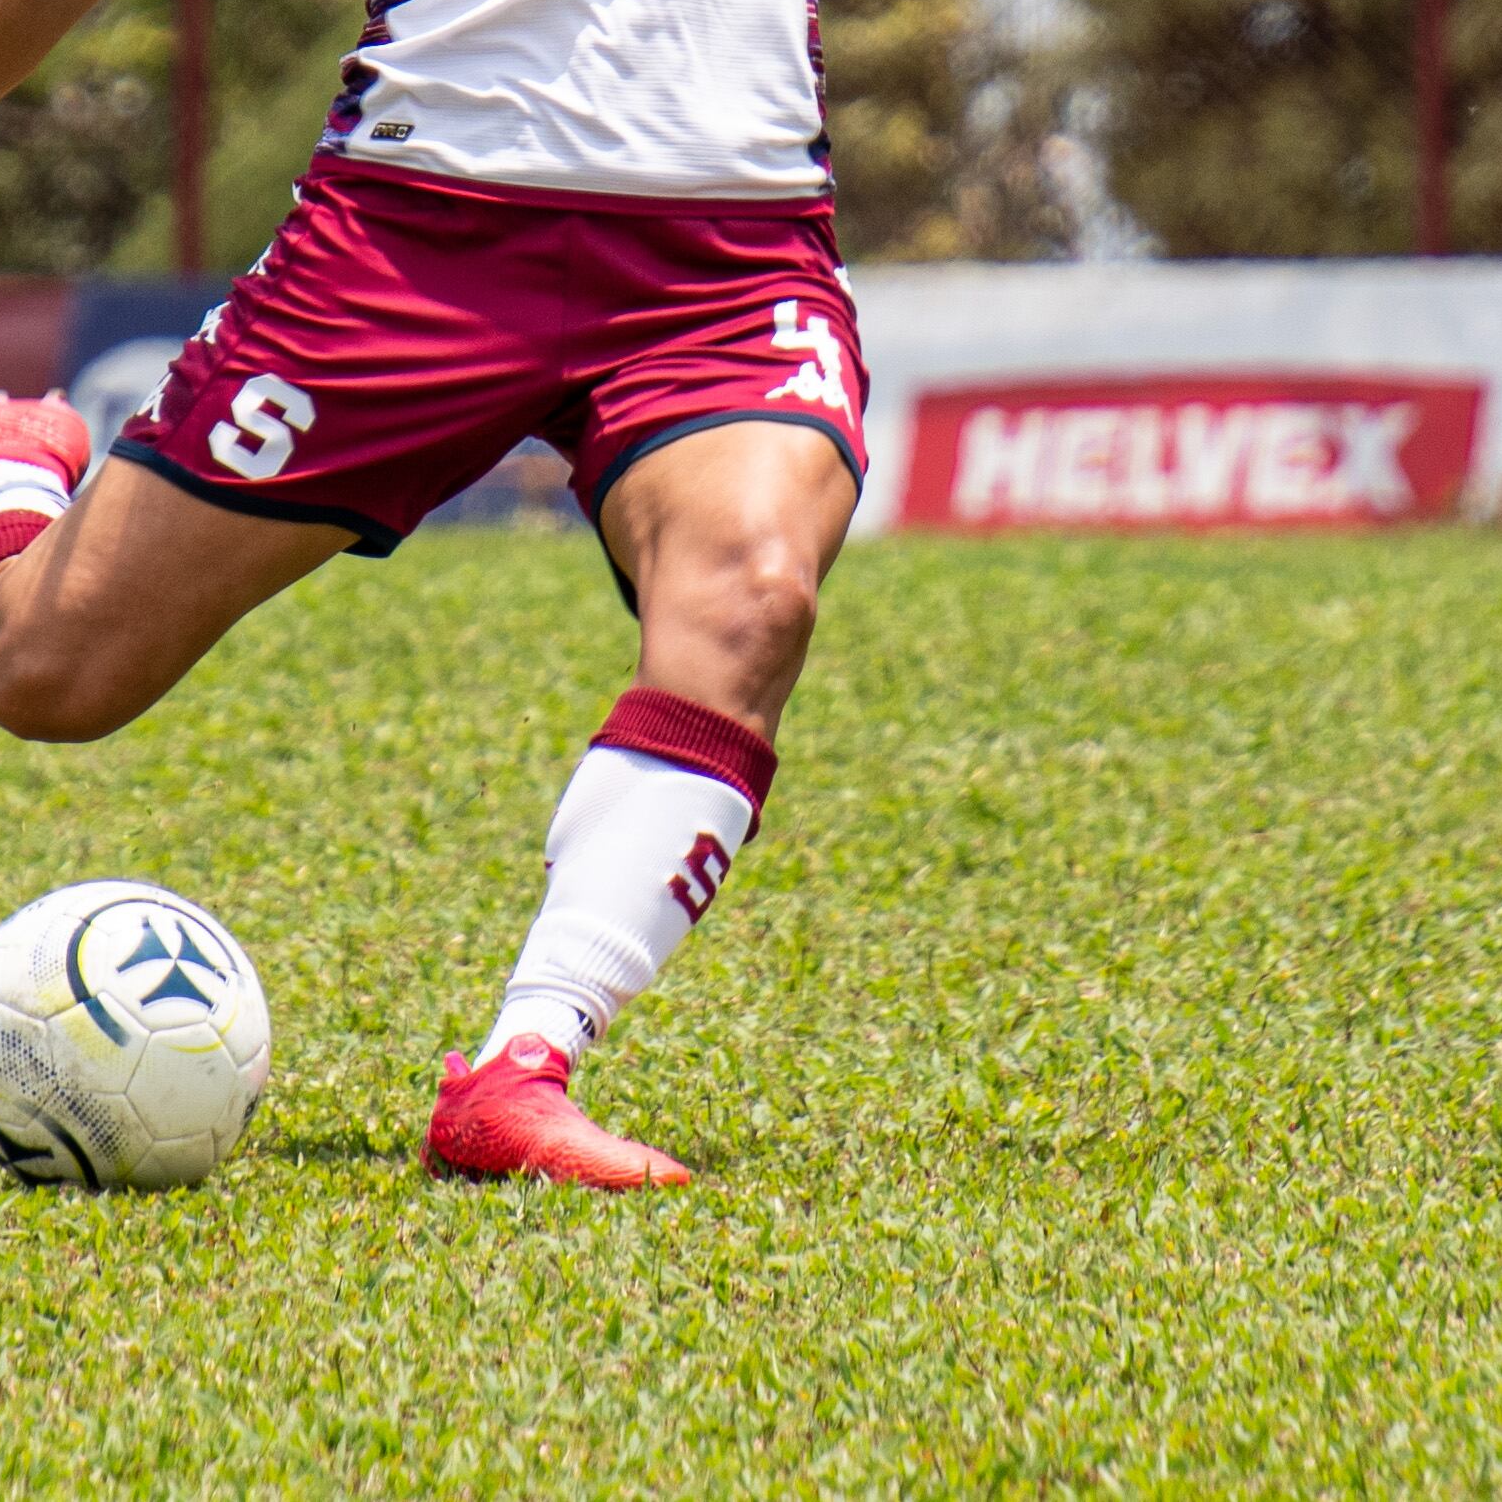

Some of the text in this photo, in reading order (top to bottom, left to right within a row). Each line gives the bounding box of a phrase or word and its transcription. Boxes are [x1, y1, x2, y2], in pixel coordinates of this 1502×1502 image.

[208, 372, 317, 481] S
[948, 398, 1425, 524] HELVEX
[668, 832, 731, 926] S
